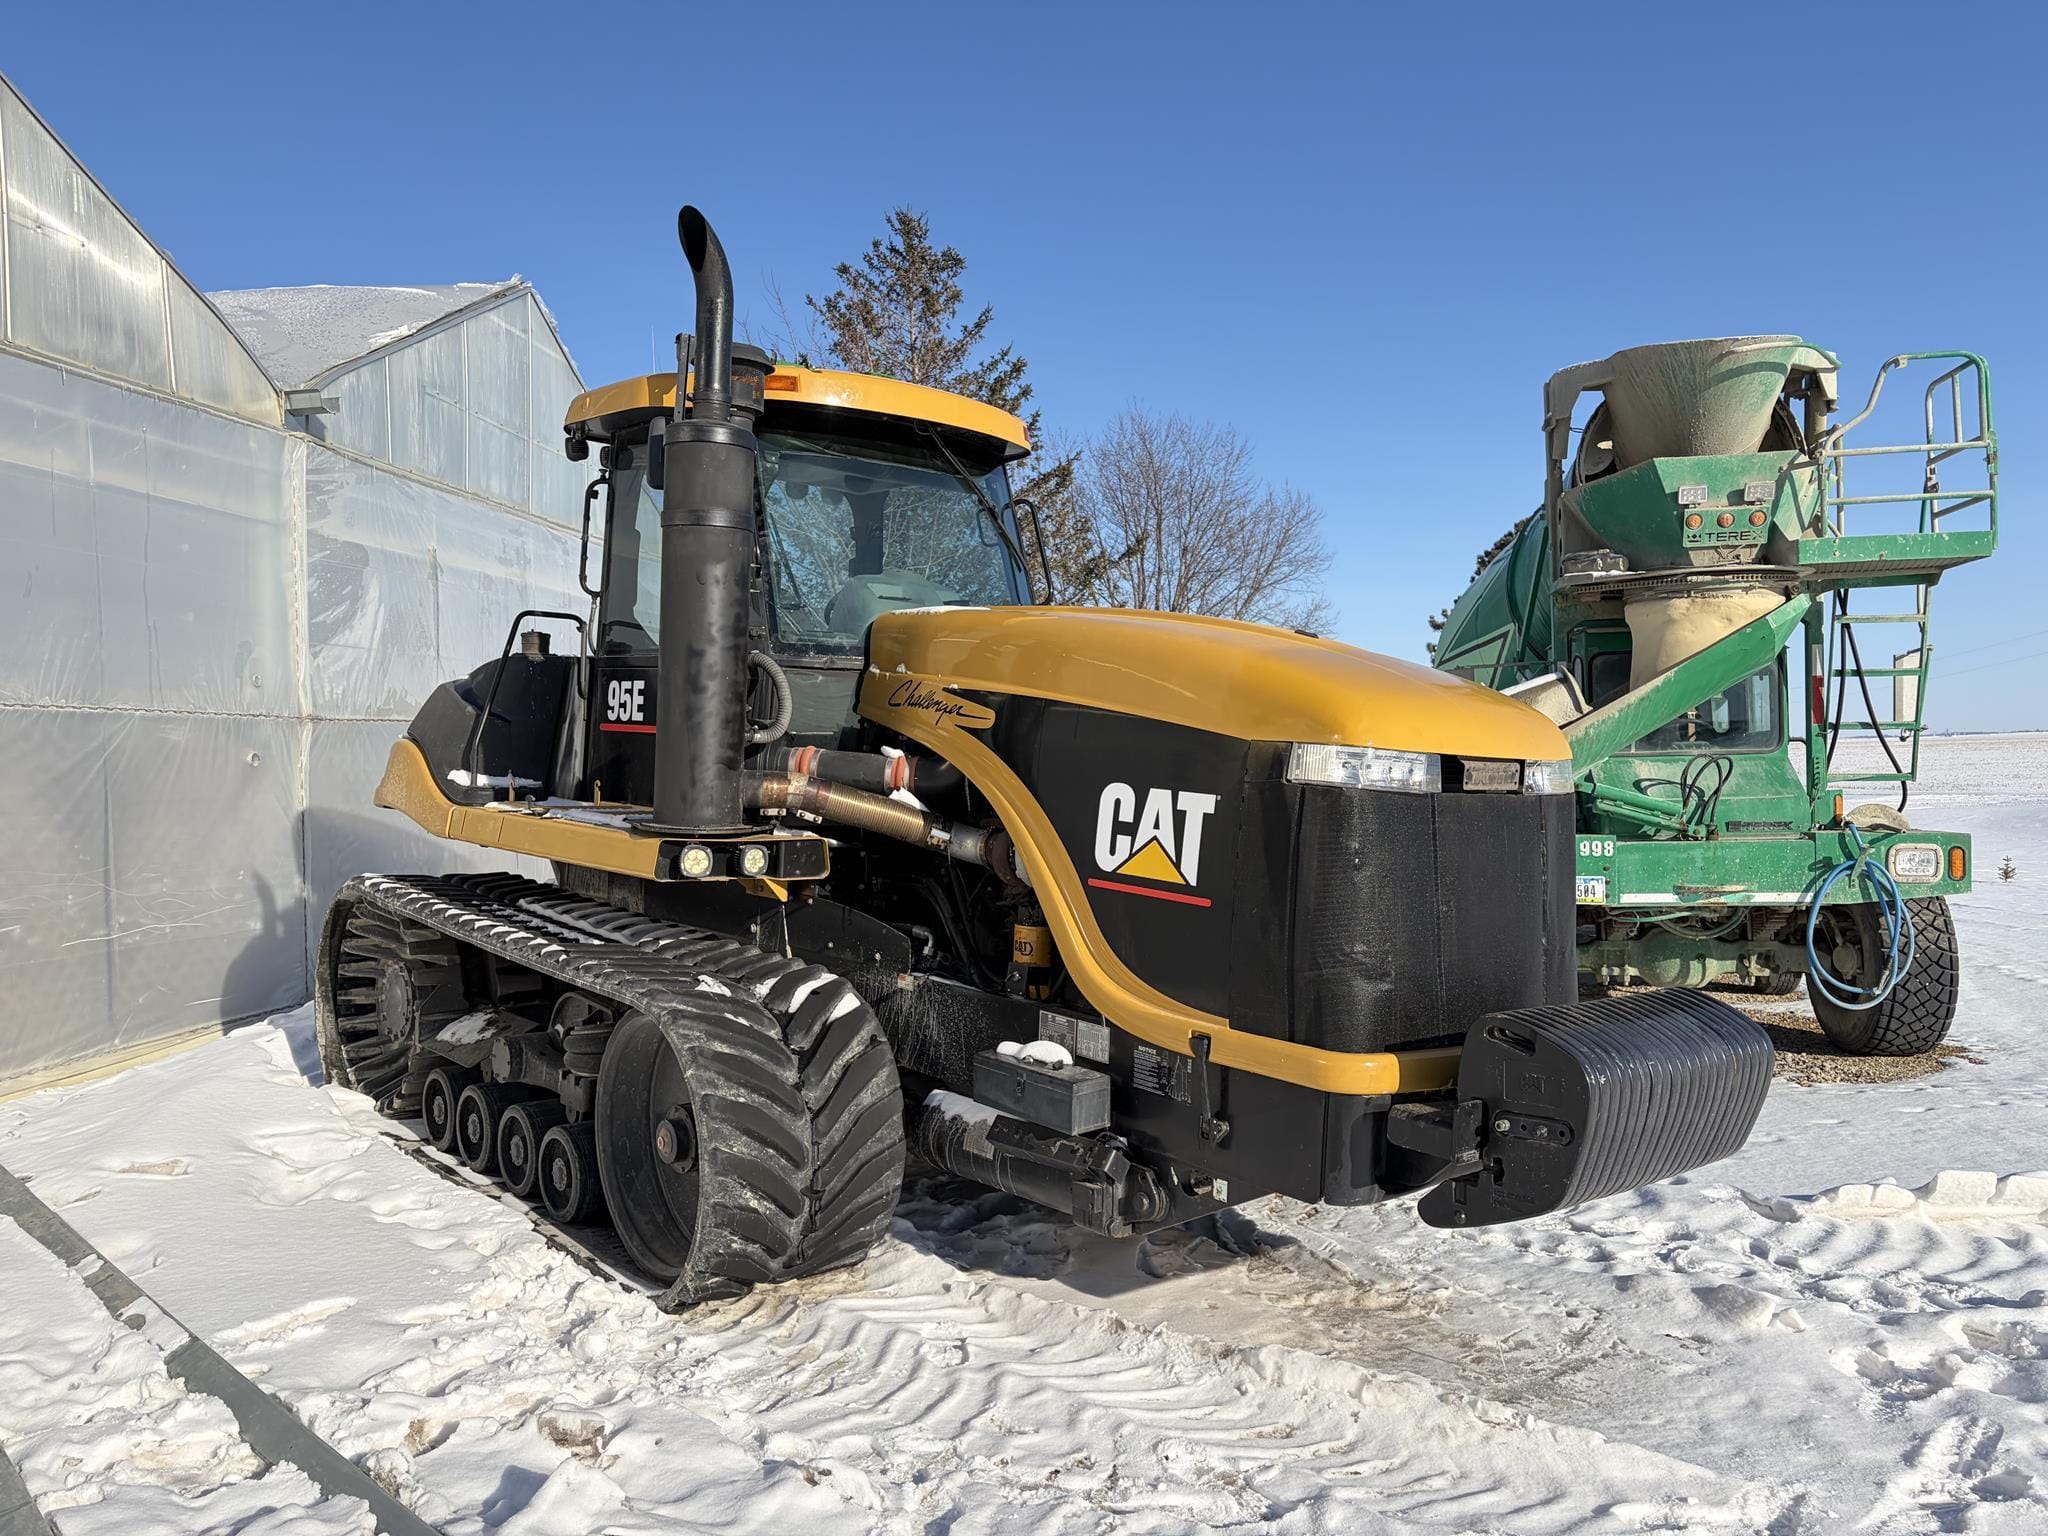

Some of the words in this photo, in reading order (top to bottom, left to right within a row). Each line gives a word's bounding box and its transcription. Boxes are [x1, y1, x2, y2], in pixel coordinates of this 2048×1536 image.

[1705, 530, 1764, 542] TEREX
[607, 680, 645, 721] 95E
[888, 680, 991, 726] Challenger
[1094, 782, 1217, 887] CAT
[1579, 840, 1614, 857] 998
[1138, 1045, 1157, 1056] NOTICE
